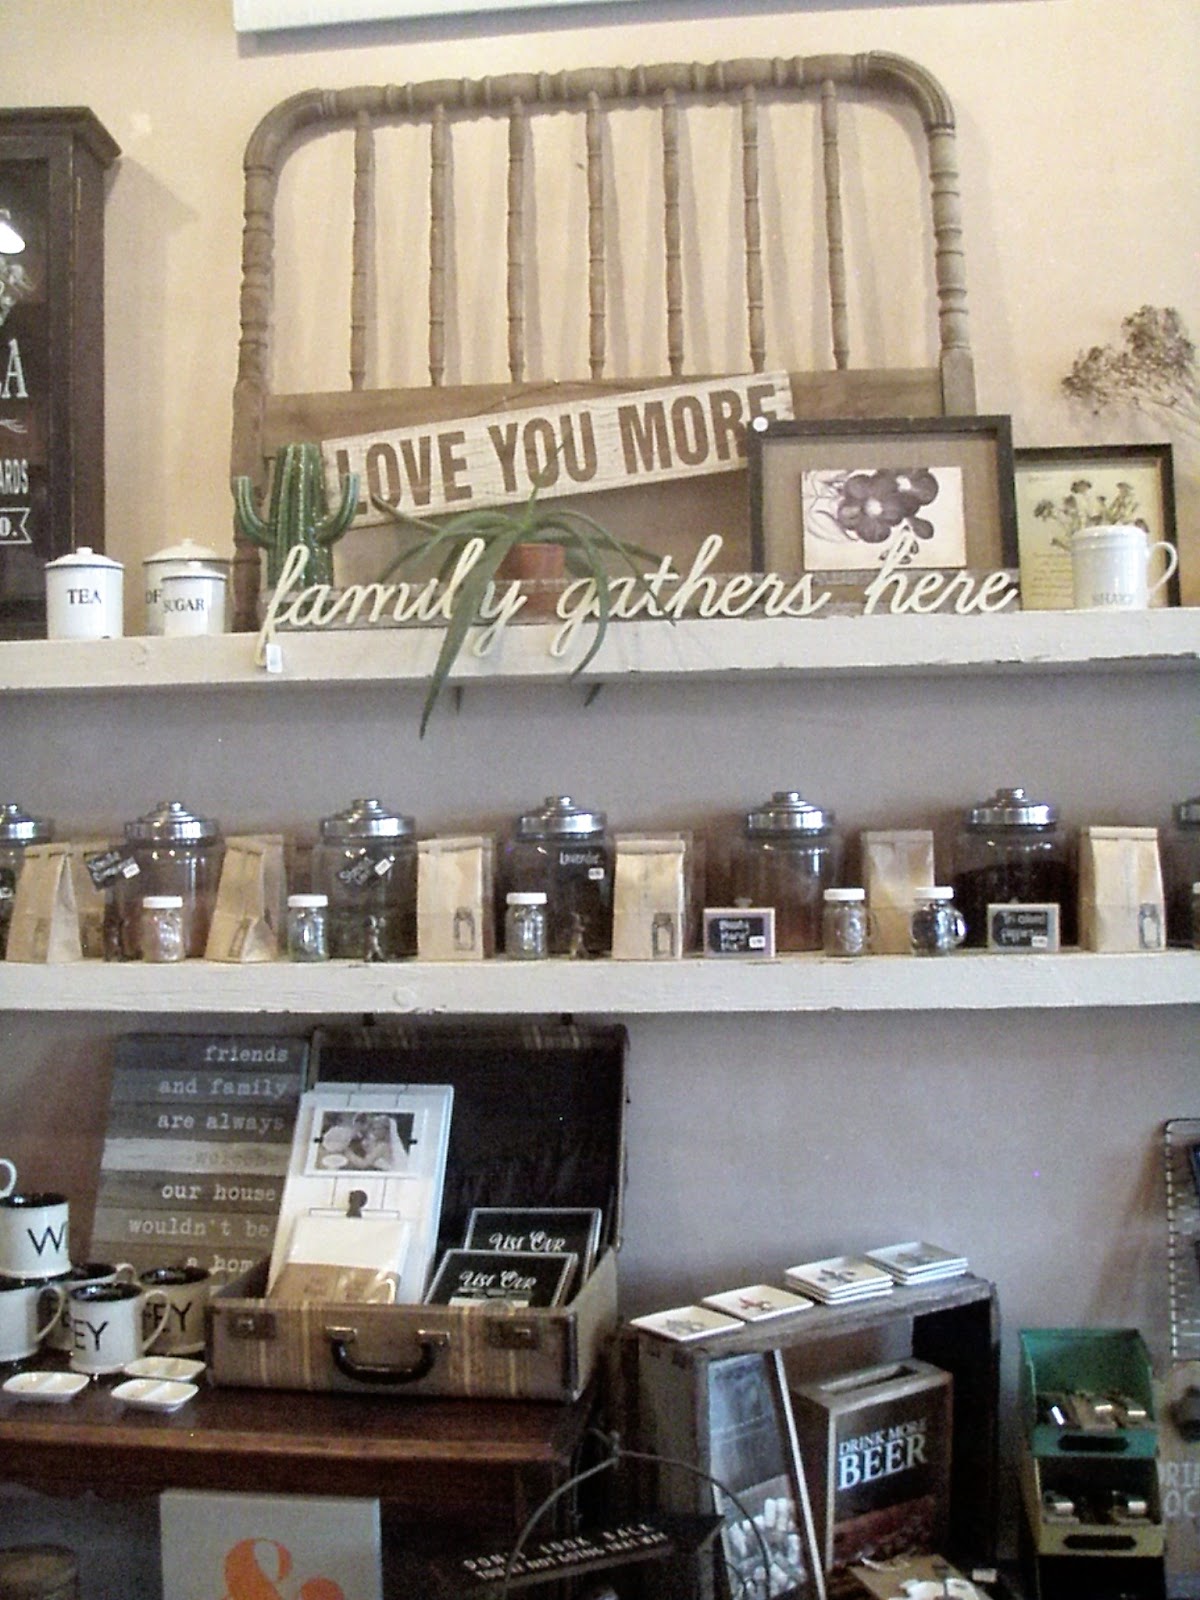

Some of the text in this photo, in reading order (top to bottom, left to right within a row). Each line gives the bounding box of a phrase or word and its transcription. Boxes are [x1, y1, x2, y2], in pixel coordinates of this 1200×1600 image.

[336, 431, 472, 515] LOVE
[487, 411, 598, 492] YOU
[67, 589, 102, 604] TEA
[253, 537, 528, 667] family
[550, 534, 832, 657] gathers
[864, 519, 1019, 616] here
[163, 597, 205, 613] SUGAR
[204, 1044, 289, 1063] friends
[159, 1077, 288, 1099] and family
[157, 1112, 285, 1134] are always
[161, 1183, 276, 1201] our house
[27, 1221, 67, 1256] W
[128, 1217, 270, 1238] wouldn't be
[213, 1254, 253, 1273] hom
[838, 1417, 928, 1456] DRINK MORE
[838, 1433, 928, 1491] BEER
